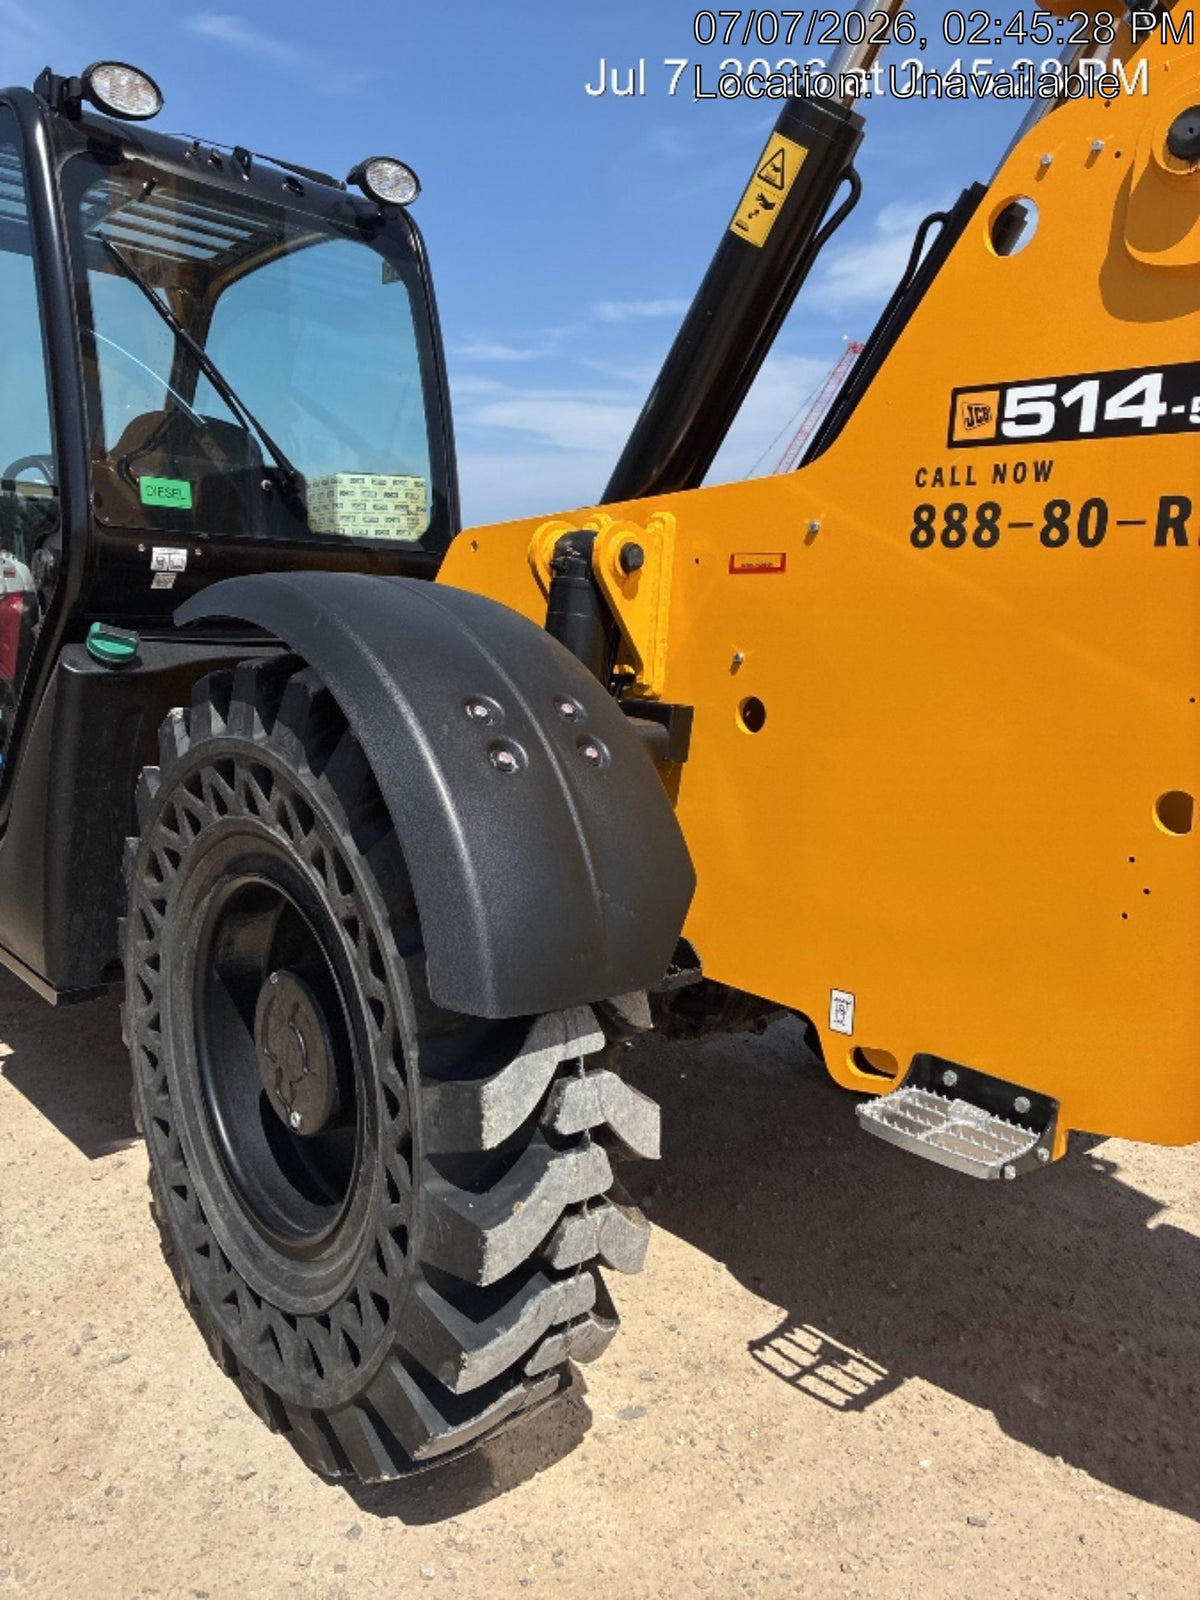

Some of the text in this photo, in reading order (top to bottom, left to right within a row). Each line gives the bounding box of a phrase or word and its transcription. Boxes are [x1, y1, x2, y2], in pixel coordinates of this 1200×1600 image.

[966, 404, 991, 428] JCB
[915, 460, 1054, 488] CALL NOW
[145, 484, 187, 500] DIESEL
[909, 495, 1200, 549] 888-80-R
